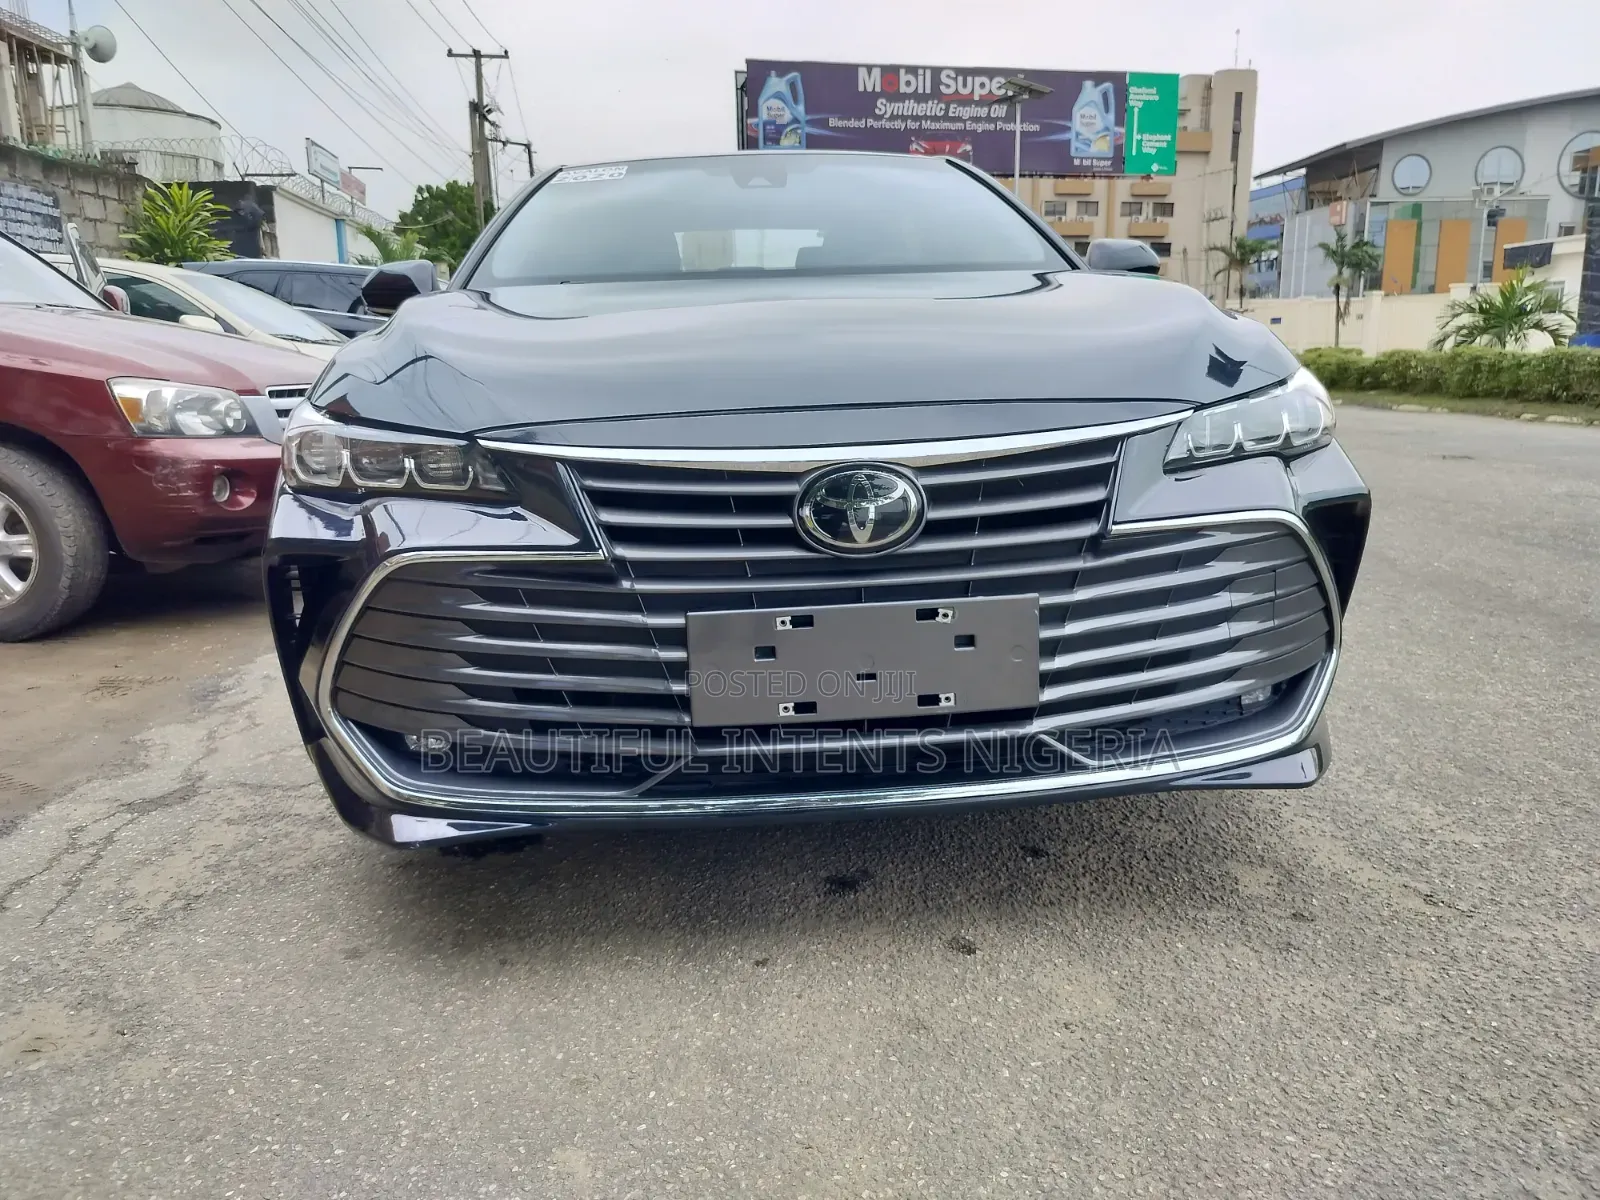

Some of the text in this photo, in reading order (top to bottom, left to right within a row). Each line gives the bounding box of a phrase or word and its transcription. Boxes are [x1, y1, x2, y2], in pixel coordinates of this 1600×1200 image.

[857, 66, 1014, 100] Mobil Supe
[874, 98, 1008, 119] Synthetic Engine Oil
[828, 117, 866, 129] Blended
[867, 118, 907, 132] Perfectly
[907, 119, 921, 130] for
[921, 119, 965, 131] Maximum
[966, 121, 996, 133] Engine
